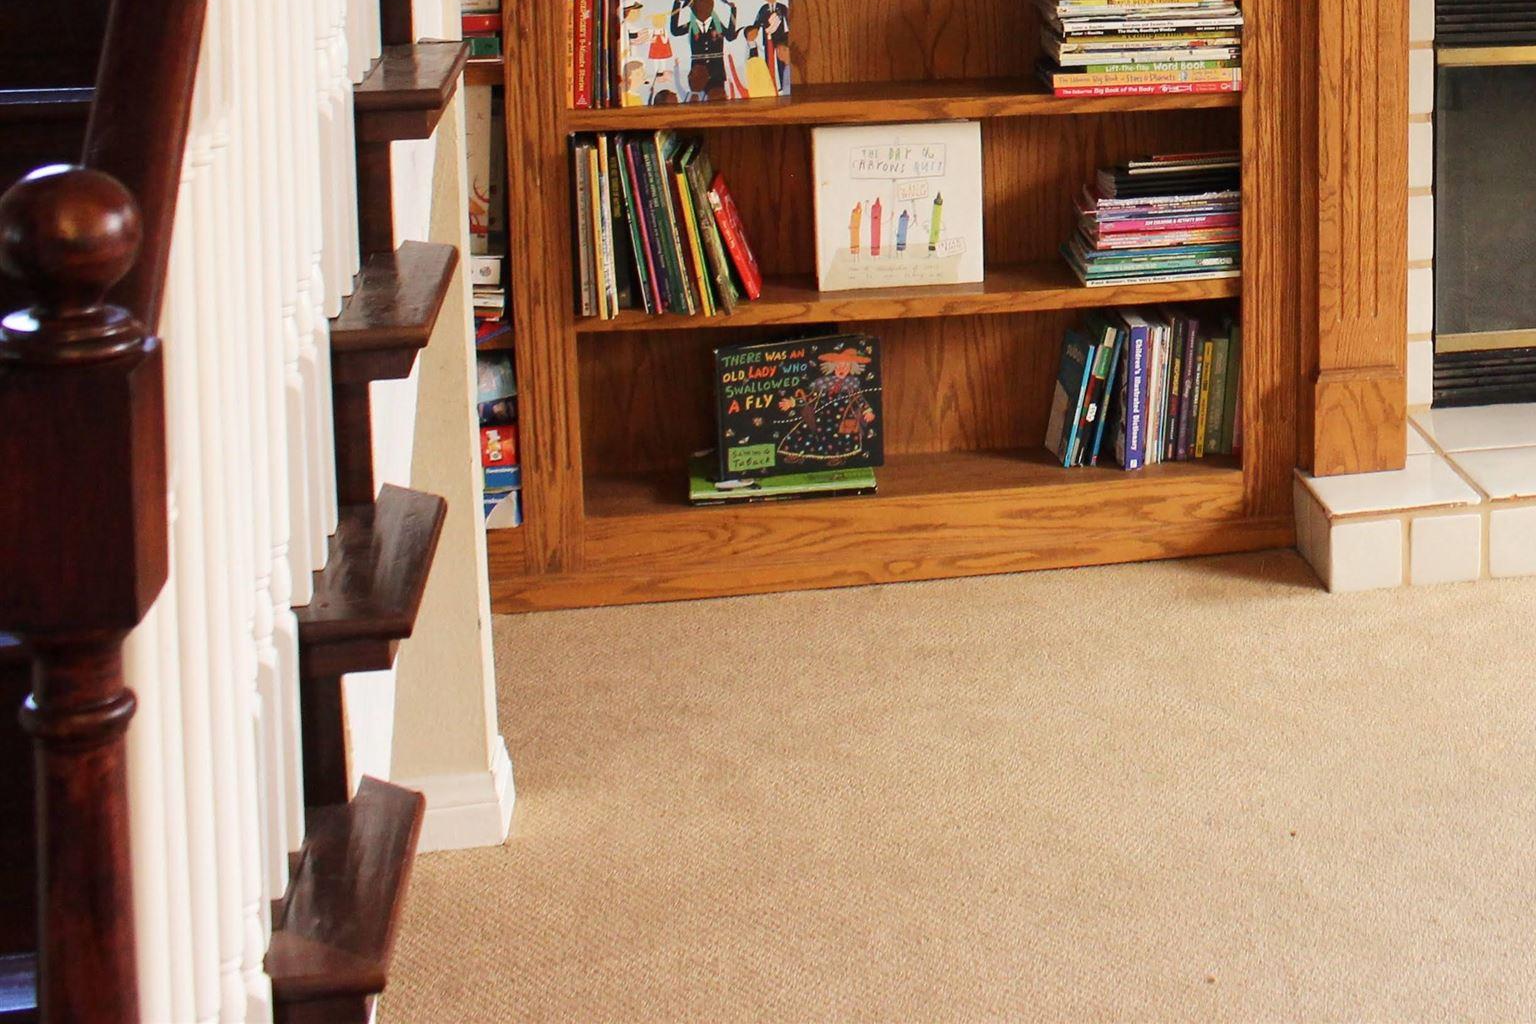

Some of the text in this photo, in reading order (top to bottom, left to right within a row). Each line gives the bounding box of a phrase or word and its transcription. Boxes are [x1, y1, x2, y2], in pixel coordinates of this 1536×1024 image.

[721, 348, 805, 367] THERE WAS AN
[722, 363, 808, 384] OLD LADY WHO
[725, 376, 800, 398] SWALLOWED
[1131, 338, 1143, 451] Children's Illustrated Dictionary
[728, 394, 774, 415] A FLY
